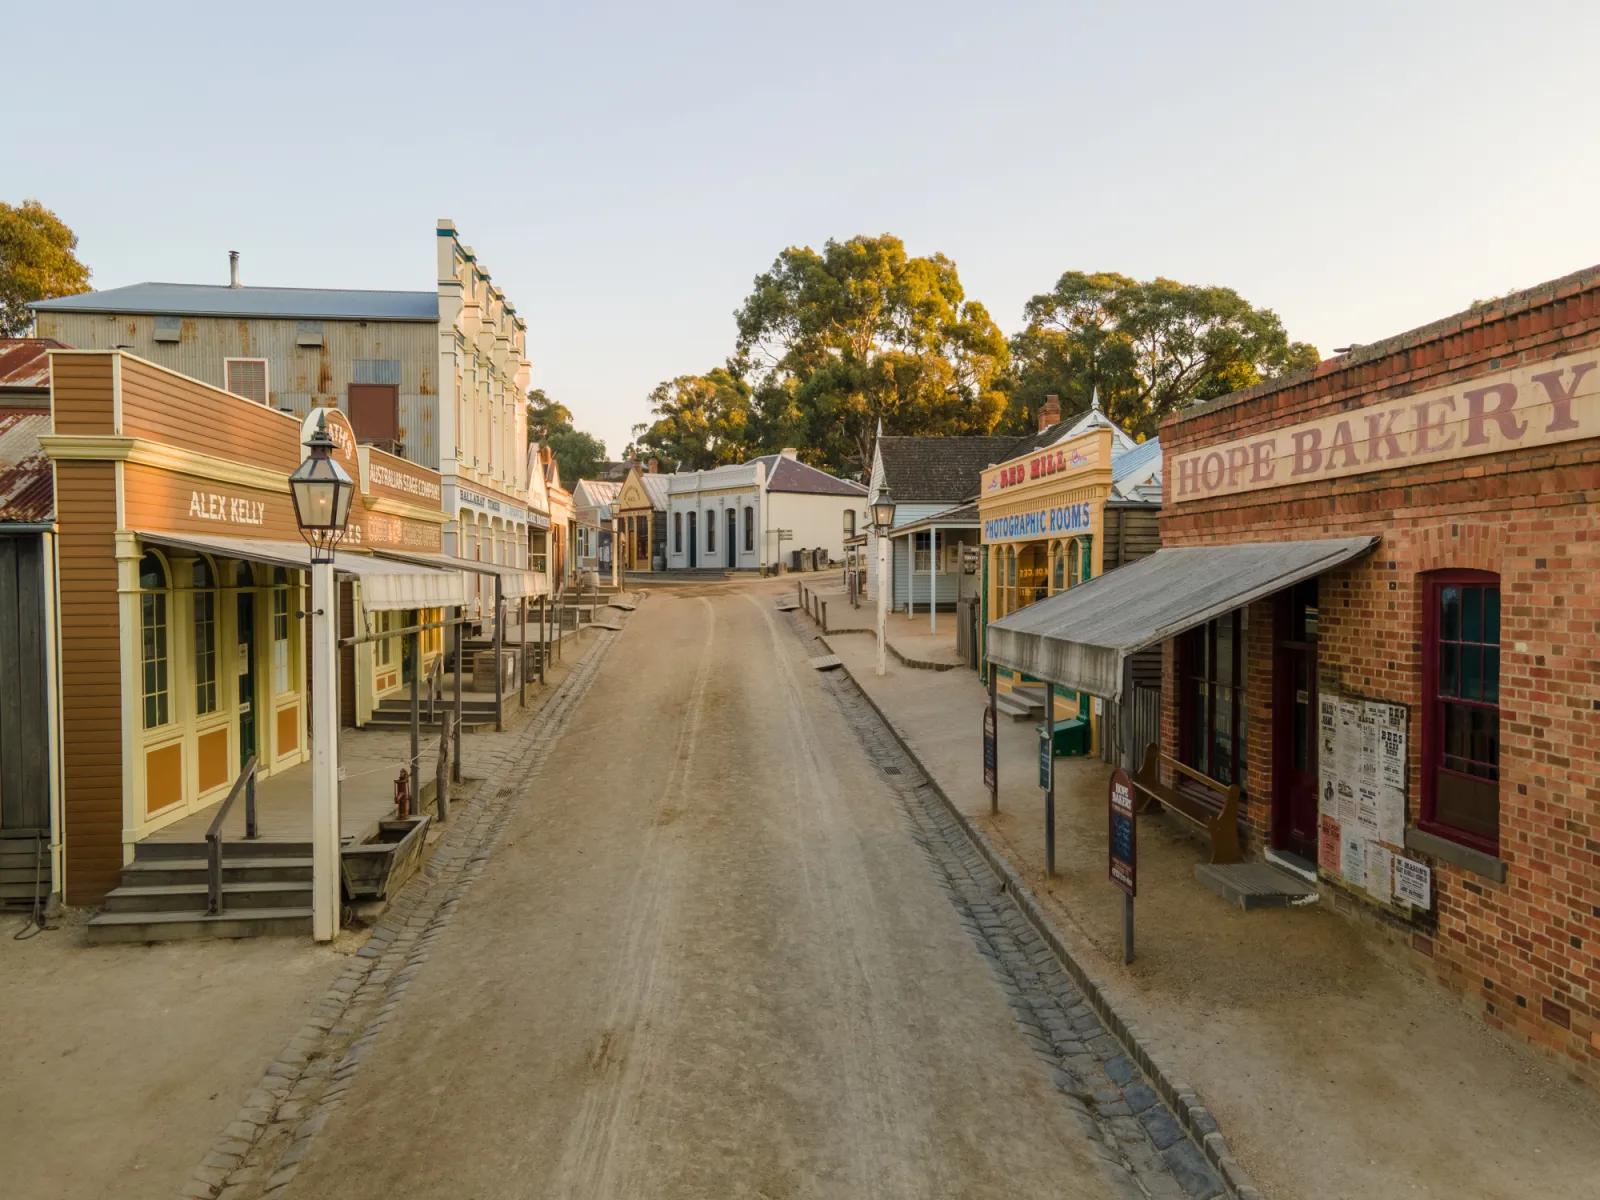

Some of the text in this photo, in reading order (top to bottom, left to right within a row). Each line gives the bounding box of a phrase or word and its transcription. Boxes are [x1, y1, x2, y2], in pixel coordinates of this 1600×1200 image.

[1176, 361, 1599, 497] HOPE BAKERY
[369, 463, 441, 501] AUSTRALIAN STAGE COMPANY
[999, 450, 1067, 489] RED HILL
[189, 491, 266, 526] ALEX KELLY
[984, 502, 1090, 539] PHOTOGRAPHIC ROOMS
